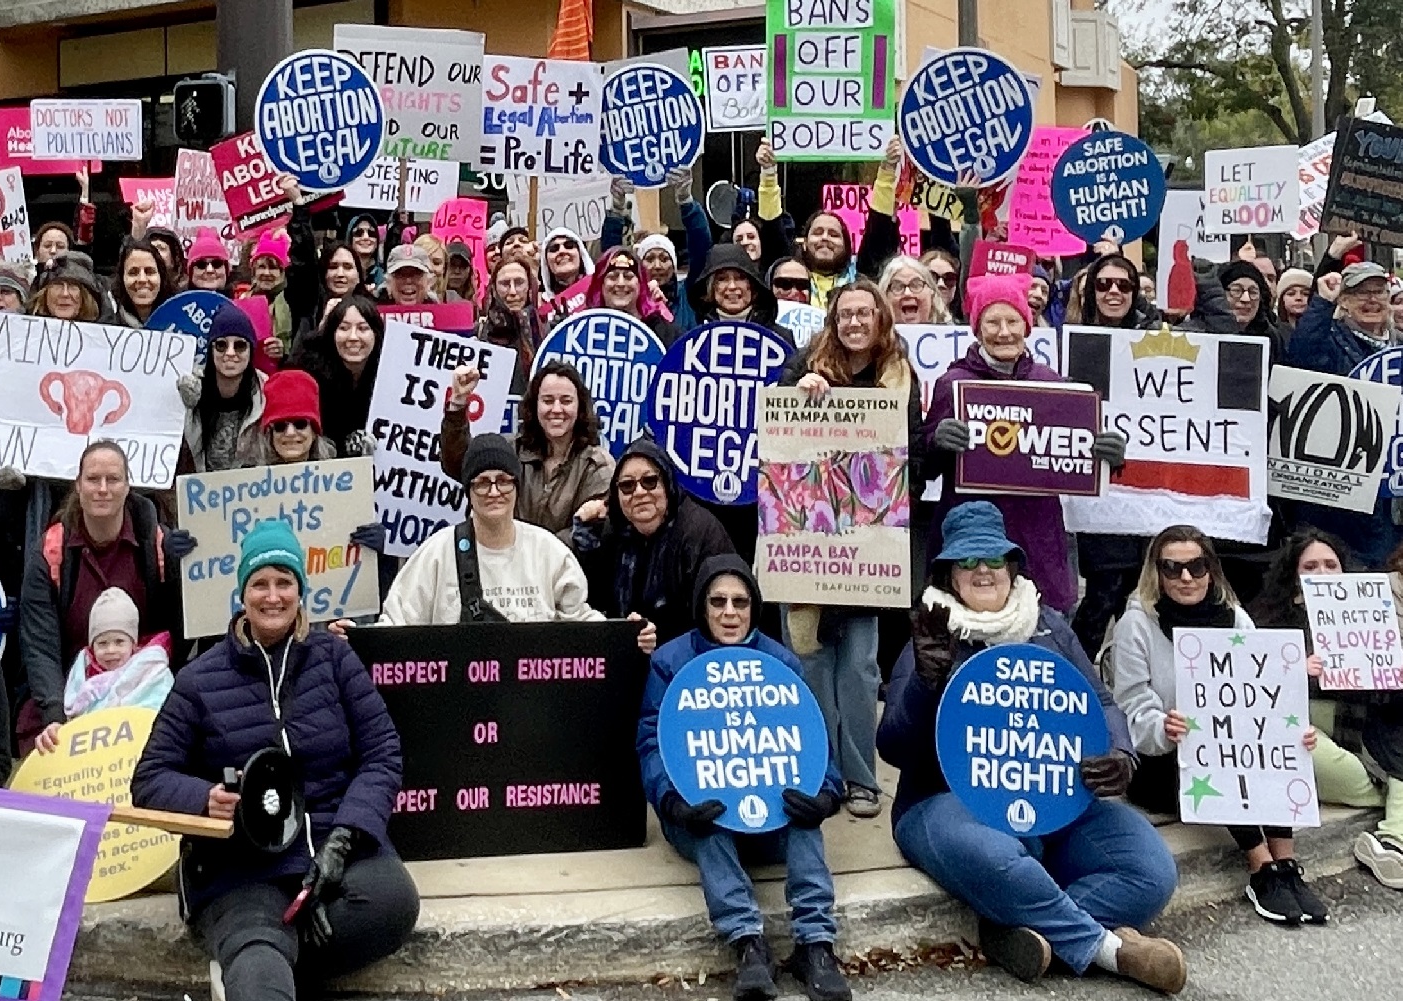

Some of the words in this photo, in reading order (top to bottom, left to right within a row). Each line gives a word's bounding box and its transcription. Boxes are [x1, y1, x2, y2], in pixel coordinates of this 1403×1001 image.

[787, 0, 871, 27] BANS
[798, 35, 861, 67] OFF
[276, 57, 352, 99] KEEP
[448, 62, 481, 84] OUR
[485, 61, 560, 105] Safe
[717, 74, 762, 92] OFF
[913, 53, 989, 99] KEEP
[381, 86, 462, 113] RIGHTS
[605, 71, 673, 109] KEEP
[794, 80, 861, 107] OUR
[35, 108, 94, 128] DOCTORS
[105, 109, 131, 128] NOT
[263, 88, 378, 140] ABORTION
[484, 106, 534, 134] Legal
[536, 107, 594, 136] Abortion
[600, 94, 696, 145] ABORTION
[905, 72, 1026, 149] ABORTION
[47, 131, 133, 155] POLITICIANS
[421, 122, 459, 140] OUR
[771, 120, 884, 152] BODIES
[927, 116, 1024, 173] LEGAL
[278, 127, 371, 172] LEGAL
[384, 137, 453, 160] UTURE
[609, 130, 691, 172] LEGAL
[1083, 138, 1124, 157] SAFE
[1063, 150, 1148, 177] ABORTION
[1221, 163, 1256, 183] LET
[1096, 173, 1107, 183] IS
[1109, 172, 1118, 181] A
[1069, 178, 1150, 205] HUMAN
[1209, 180, 1287, 203] EQUALITY
[1076, 197, 1147, 225] RIGHT!
[1221, 203, 1284, 228] BLOOM
[103, 325, 181, 378] YOUR
[565, 317, 649, 359] KEEP
[683, 326, 786, 378] KEEP
[401, 373, 439, 410] IS
[1133, 364, 1195, 403] WE
[765, 397, 798, 409] NEED
[827, 399, 898, 411] ABORTION
[765, 411, 779, 423] IN
[784, 412, 829, 424] TAMPA
[834, 412, 866, 424] BAY?
[967, 404, 1033, 422] WOMEN
[1031, 456, 1050, 470] THE
[1051, 457, 1094, 475] VOTE
[186, 465, 354, 521] Reproductive
[767, 543, 822, 560] TAMPA
[829, 545, 859, 560] BAY
[188, 554, 236, 581] are
[767, 559, 853, 577] ABORTION
[859, 564, 902, 577] FUND
[1356, 581, 1385, 598] NOT
[1317, 609, 1336, 627] AN
[1341, 609, 1368, 625] ACT
[1372, 609, 1390, 624] OF
[1336, 630, 1383, 650] LOVE
[372, 660, 448, 685] RESPECT
[468, 660, 500, 683] OUR
[517, 657, 606, 681] EXISTENCE
[706, 659, 764, 684] SAFE
[995, 656, 1055, 685] SAFE
[1209, 652, 1268, 678] MY
[1328, 653, 1345, 669] IF
[1365, 653, 1393, 668] YOU
[1322, 667, 1363, 689] MAKE
[677, 683, 799, 711] ABORTION
[961, 681, 1088, 715] ABORTION
[1194, 683, 1282, 709] BODY
[725, 710, 744, 727] IS
[745, 710, 756, 726] A
[1008, 711, 1026, 729] IS
[1028, 712, 1040, 730] A
[1212, 715, 1266, 741] MY
[69, 720, 134, 757] ERA
[473, 721, 498, 744] OR
[686, 724, 802, 758] HUMAN
[965, 724, 1082, 763] HUMAN
[108, 757, 124, 773] of
[695, 753, 801, 789] RIGHT!
[1196, 744, 1298, 771] CHOICE
[81, 780, 105, 797] the
[970, 759, 1075, 797] RIGHT!
[456, 786, 489, 810] OUR
[505, 783, 601, 808] RESISTANCE
[111, 831, 176, 857] account
